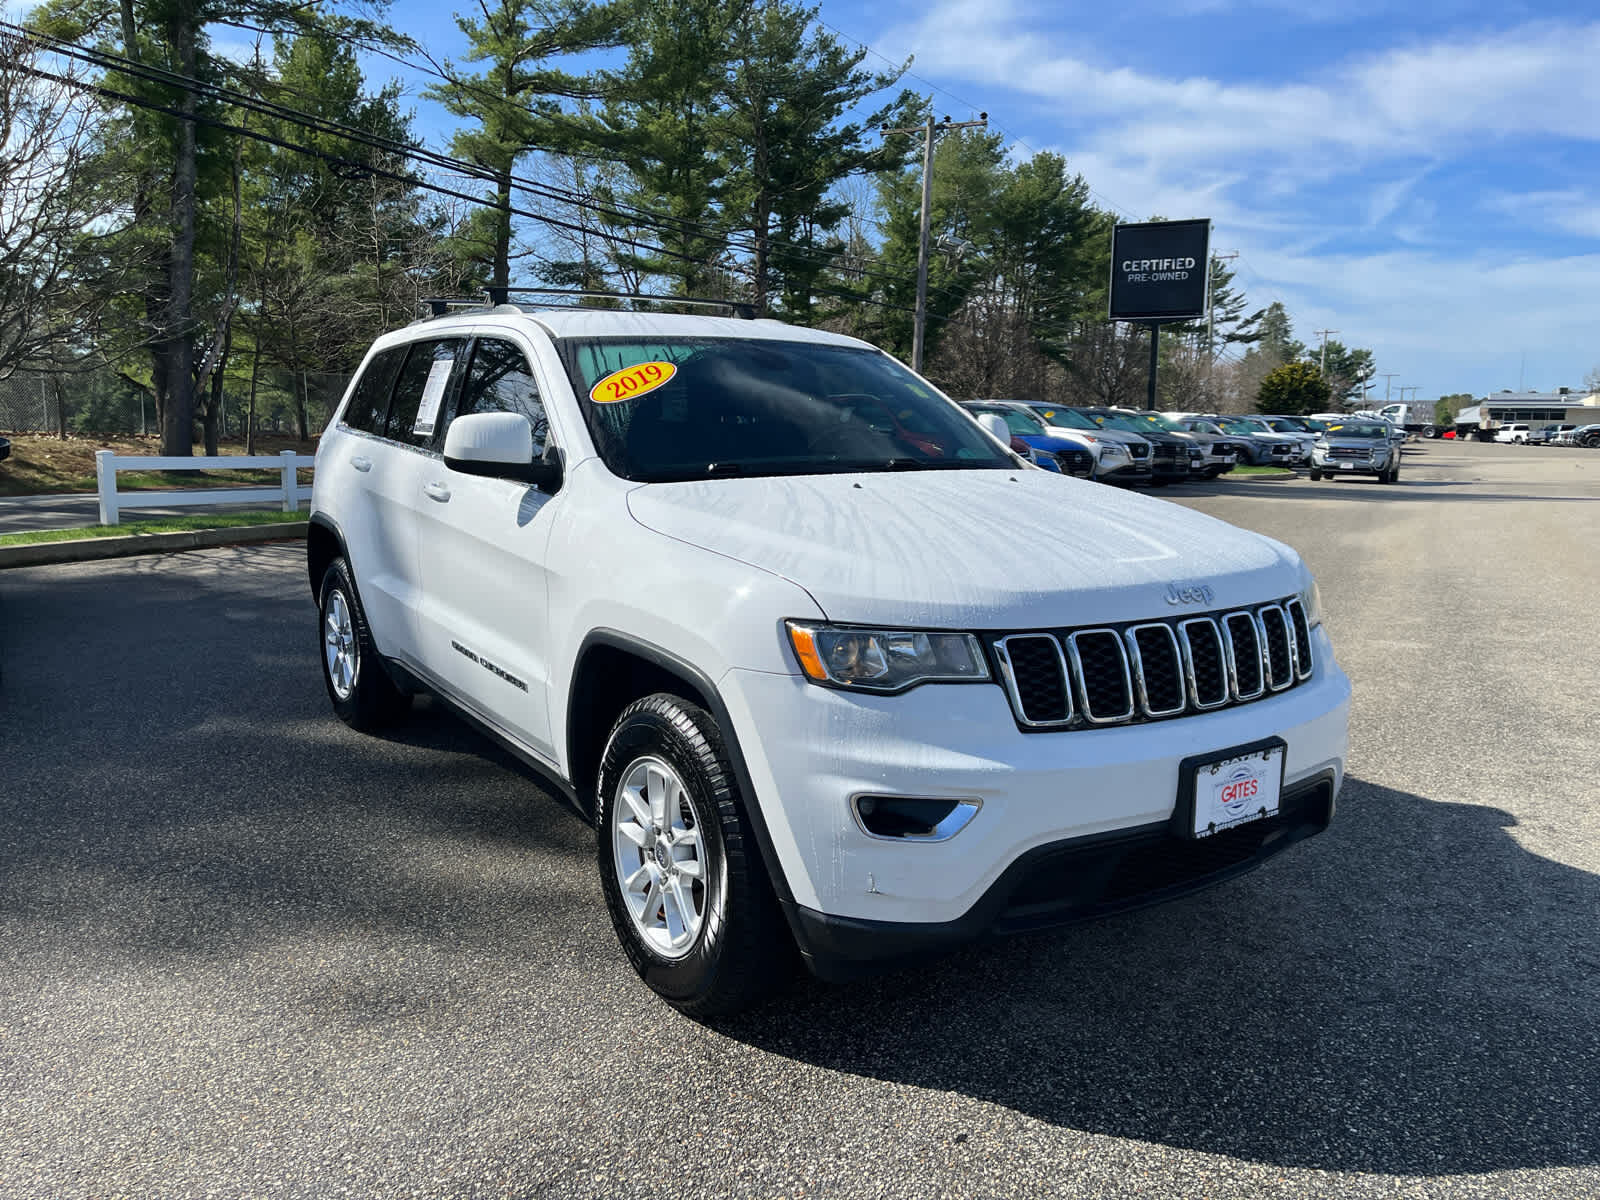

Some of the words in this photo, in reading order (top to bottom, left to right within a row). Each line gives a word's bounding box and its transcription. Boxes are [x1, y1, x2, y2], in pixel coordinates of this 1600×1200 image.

[1122, 257, 1196, 272] CERTIFIED
[1127, 271, 1189, 282] PRE-OWNED
[606, 365, 662, 398] 2019
[1163, 583, 1213, 607] Jeep
[1221, 779, 1258, 802] GATES
